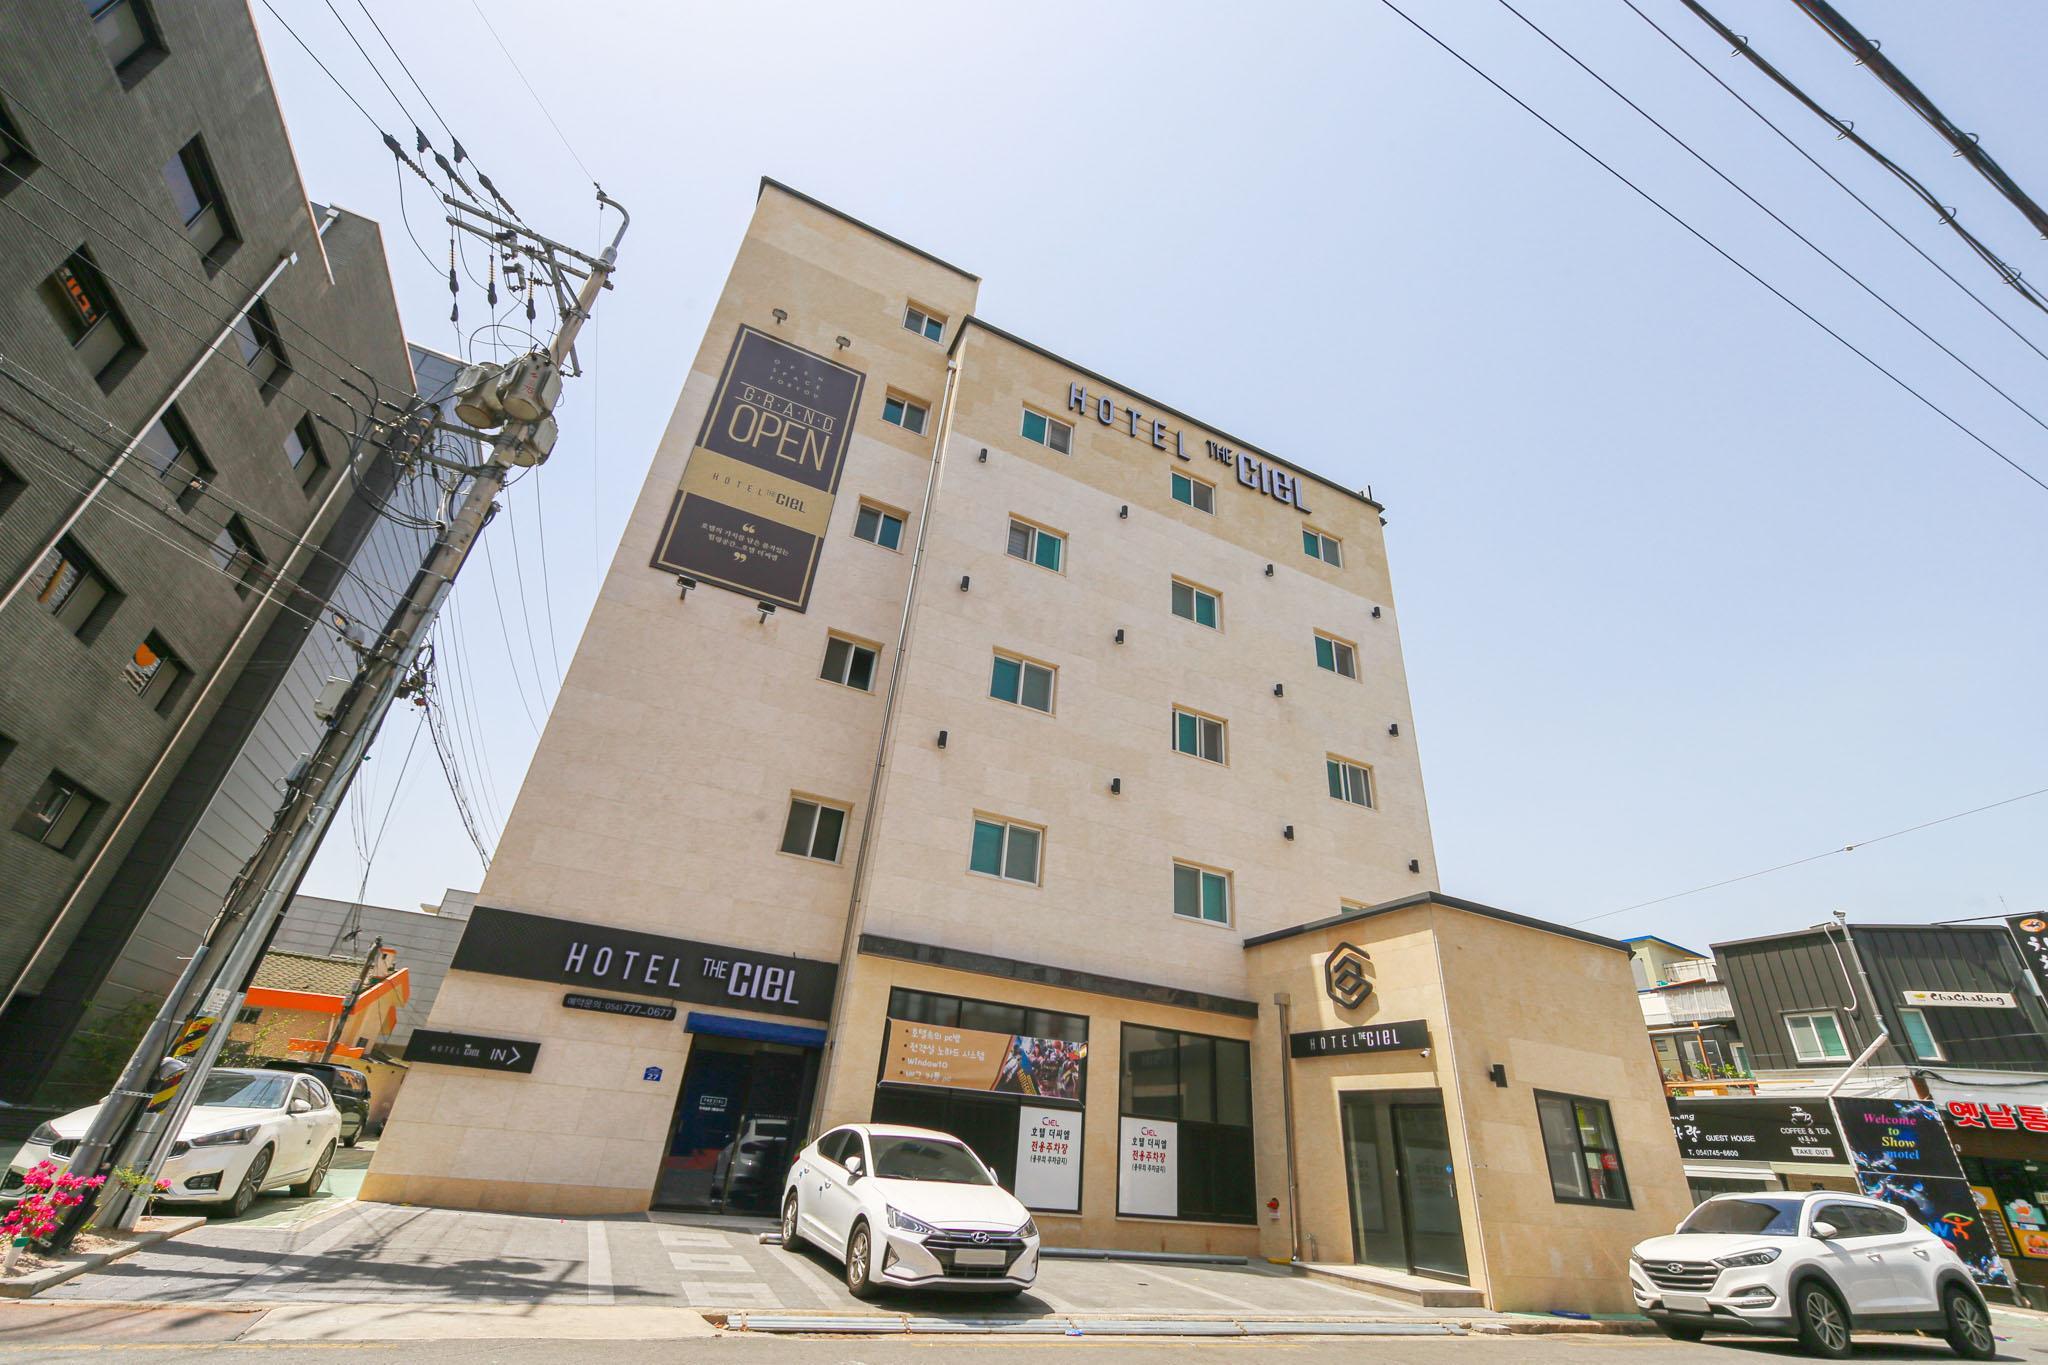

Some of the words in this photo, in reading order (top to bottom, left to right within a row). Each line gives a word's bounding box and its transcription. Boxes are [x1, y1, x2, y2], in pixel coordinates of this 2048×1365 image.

[1068, 381, 1191, 462] HOTEL
[1205, 439, 1233, 467] THE
[728, 404, 830, 471] OPEN
[712, 472, 762, 496] HOTEL
[564, 942, 681, 988] HOTEL
[703, 957, 729, 979] THE
[1309, 1034, 1359, 1050] HOTEL
[1357, 1031, 1366, 1041] THE
[490, 1048, 507, 1061] IN
[1042, 1116, 1060, 1127] CIEL
[1864, 1113, 1917, 1126] Welcome
[1031, 1126, 1046, 1138] 호텔
[1048, 1128, 1070, 1140] 더씨엘
[1141, 1126, 1157, 1137] CIEL
[1780, 1127, 1807, 1135] COFFEE
[1888, 1127, 1900, 1136] to
[1131, 1137, 1145, 1148] 호텔
[1147, 1138, 1167, 1150] 더씨엘
[1731, 1135, 1756, 1143] HOUSE
[1881, 1136, 1916, 1148] Show
[1031, 1140, 1069, 1155] 전용주차장
[1132, 1150, 1166, 1164] 전용주차장
[1884, 1150, 1920, 1160] motel
